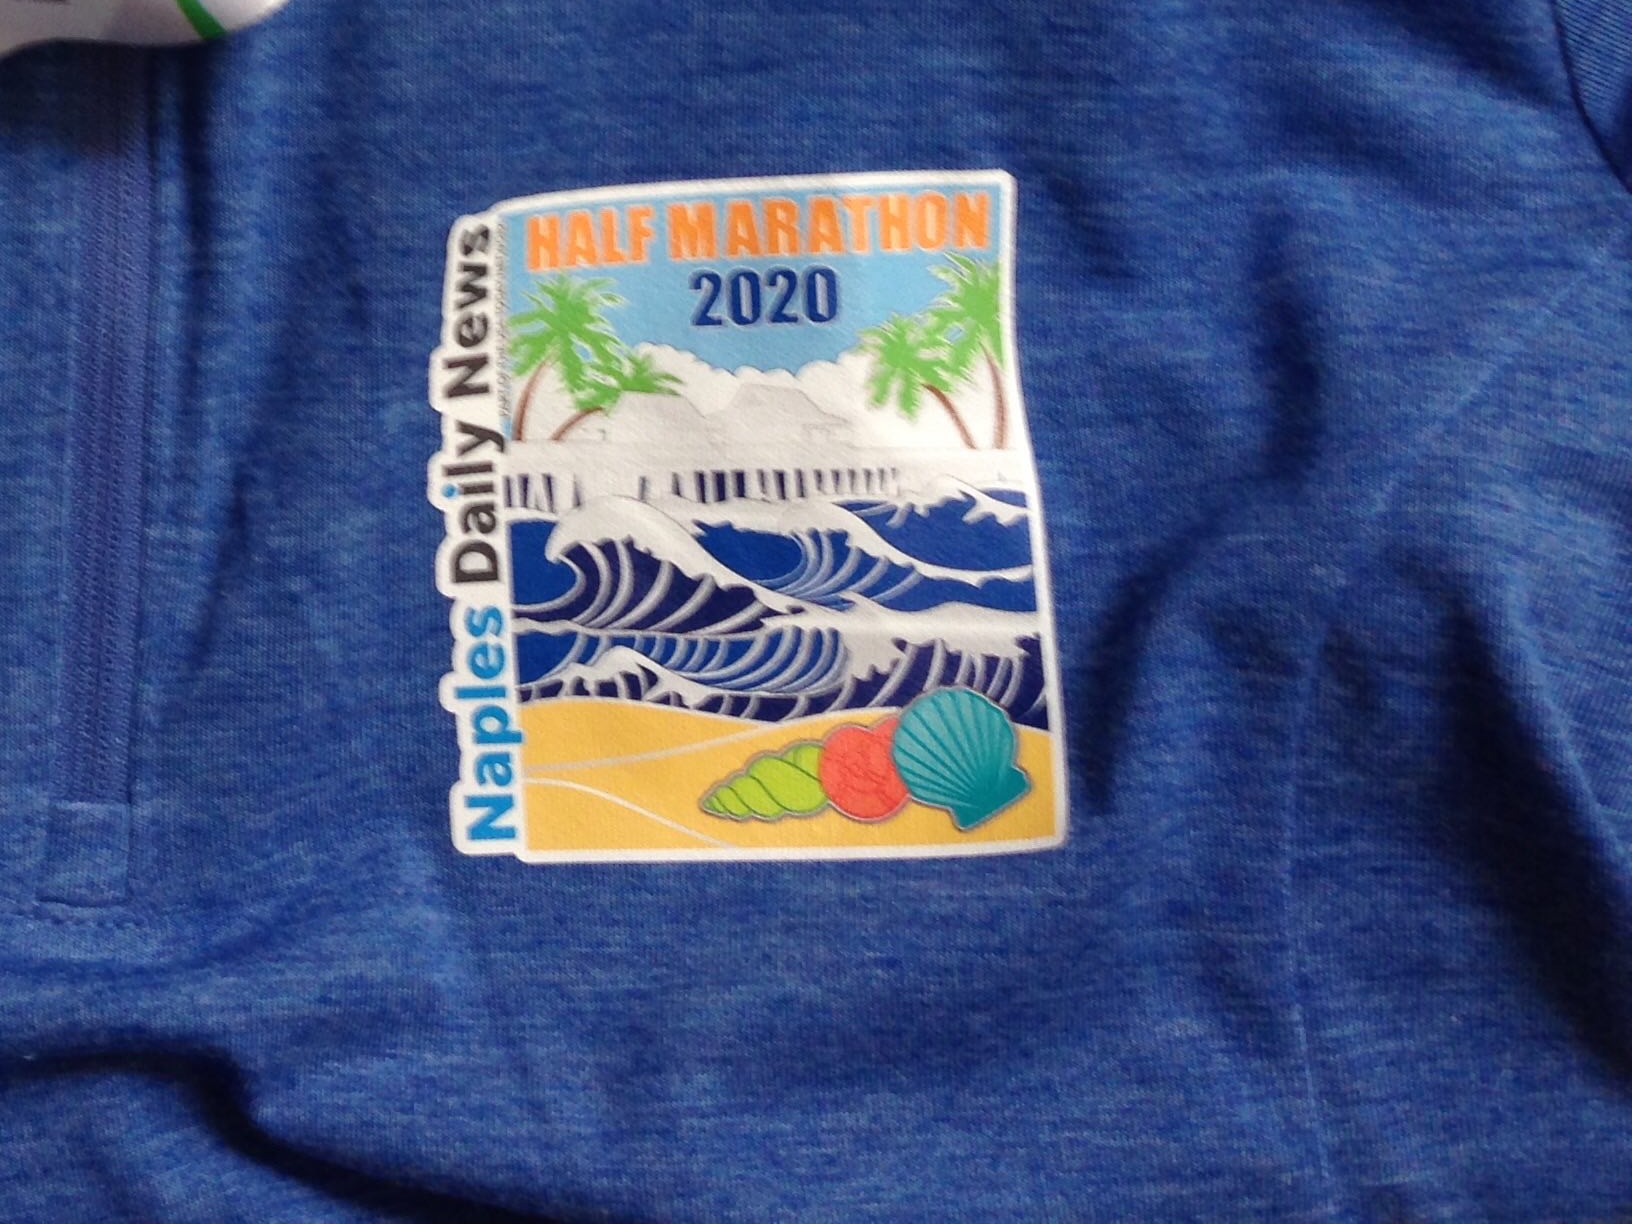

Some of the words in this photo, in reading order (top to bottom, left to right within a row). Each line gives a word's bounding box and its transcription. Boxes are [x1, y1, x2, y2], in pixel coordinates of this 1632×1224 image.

[442, 222, 492, 399] News
[526, 203, 654, 270] HALF
[669, 191, 991, 259] MARATHON
[689, 266, 839, 327] 2020
[440, 421, 505, 585] Daily
[467, 604, 525, 843] Naples
